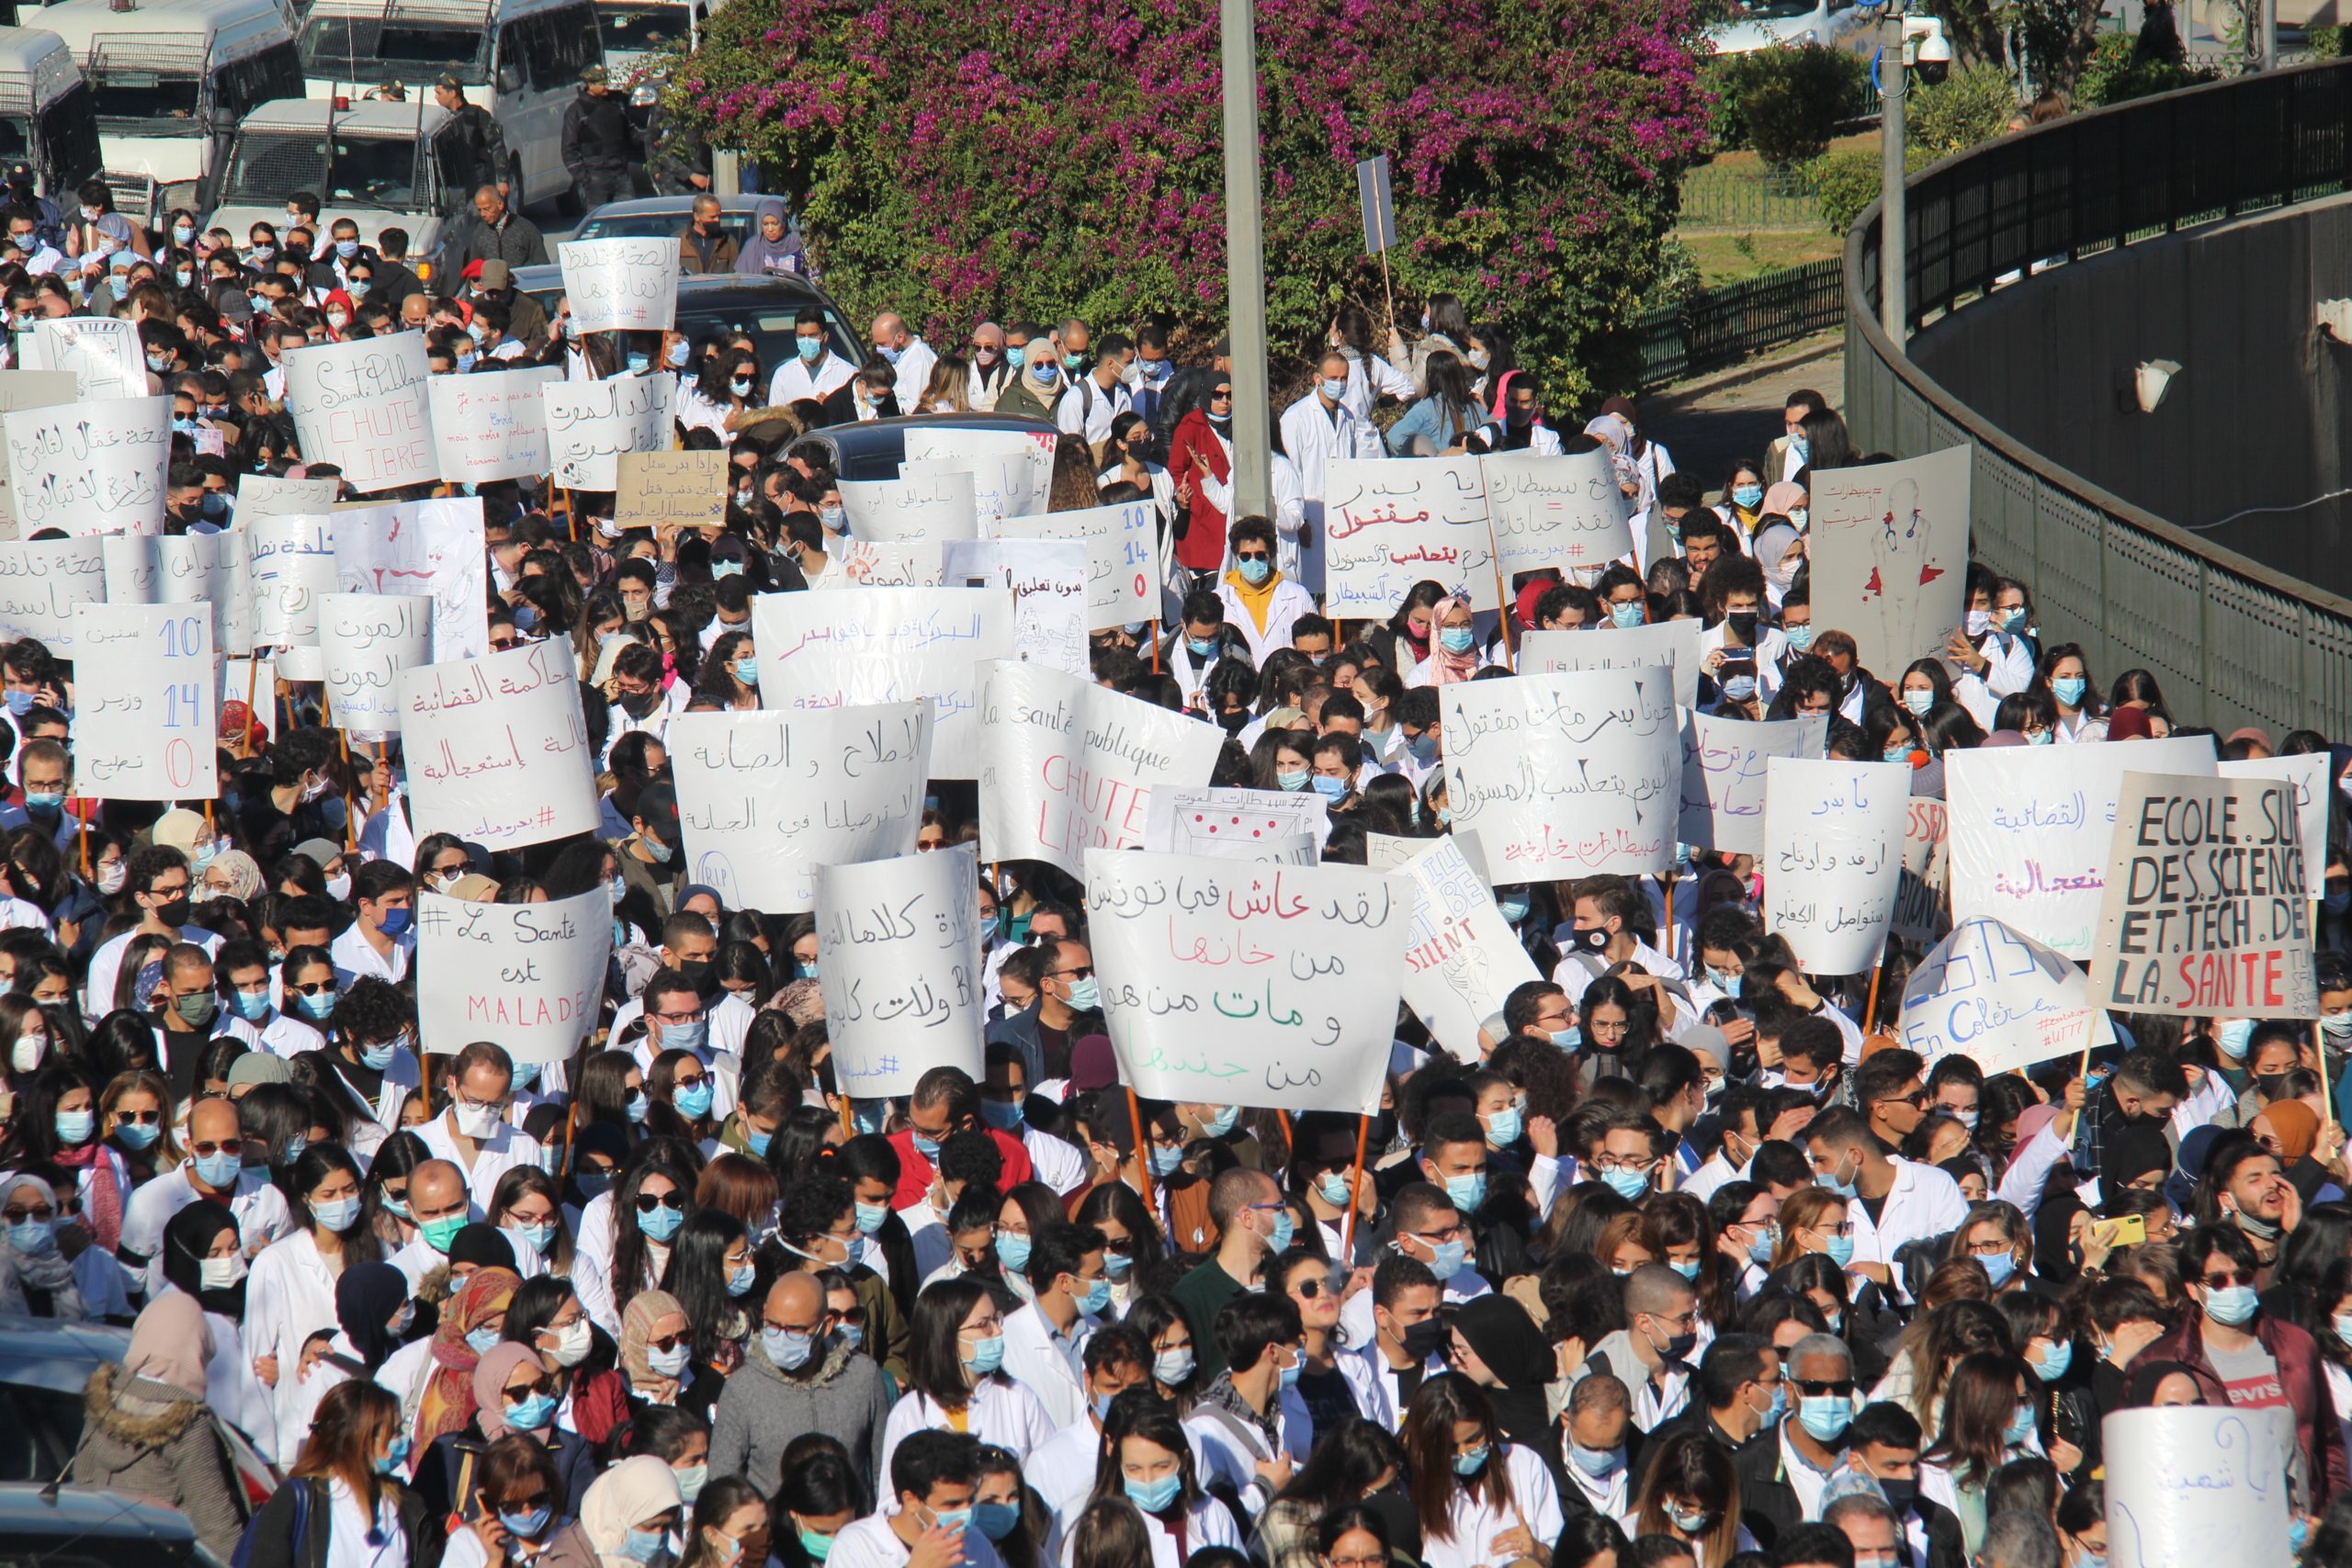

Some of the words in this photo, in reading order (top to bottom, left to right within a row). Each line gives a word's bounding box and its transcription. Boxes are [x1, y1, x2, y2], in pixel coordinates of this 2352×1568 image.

[329, 399, 424, 445] CHUTE
[550, 382, 620, 432] الموت
[342, 438, 431, 483] LIBRE
[1331, 479, 1421, 511] بدر
[1122, 505, 1146, 531] 10
[1328, 502, 1430, 540] مقتول
[1497, 503, 1563, 537] حياتك
[1123, 540, 1148, 566] 14
[1389, 544, 1459, 567] يتحاسب
[1017, 576, 1051, 598] تعليق
[85, 628, 139, 644] سنين
[158, 616, 200, 658] 10
[334, 601, 413, 649] الموت
[778, 626, 831, 661] بدر
[91, 693, 142, 713] وزير
[163, 682, 199, 728] 14
[412, 662, 493, 719] القضائية
[694, 723, 790, 773] الصيانة
[980, 681, 1001, 727] la
[1082, 721, 1171, 776] publique
[164, 738, 194, 788] 0
[1042, 754, 1152, 834] CHUTE
[777, 813, 810, 839] في
[1176, 874, 1221, 915] في
[1227, 870, 1310, 920] عاش
[1321, 881, 1390, 929] لقد
[513, 909, 578, 943] Santé
[1169, 913, 1275, 965] خانها
[1405, 917, 1476, 974] SILENT
[501, 957, 541, 983] est
[1291, 948, 1345, 981] من
[2176, 949, 2285, 1010] SANTE
[468, 990, 586, 1027] MALADE
[1148, 986, 1199, 1015] من
[1127, 1018, 1250, 1083] جندها
[1266, 1060, 1321, 1090] من
